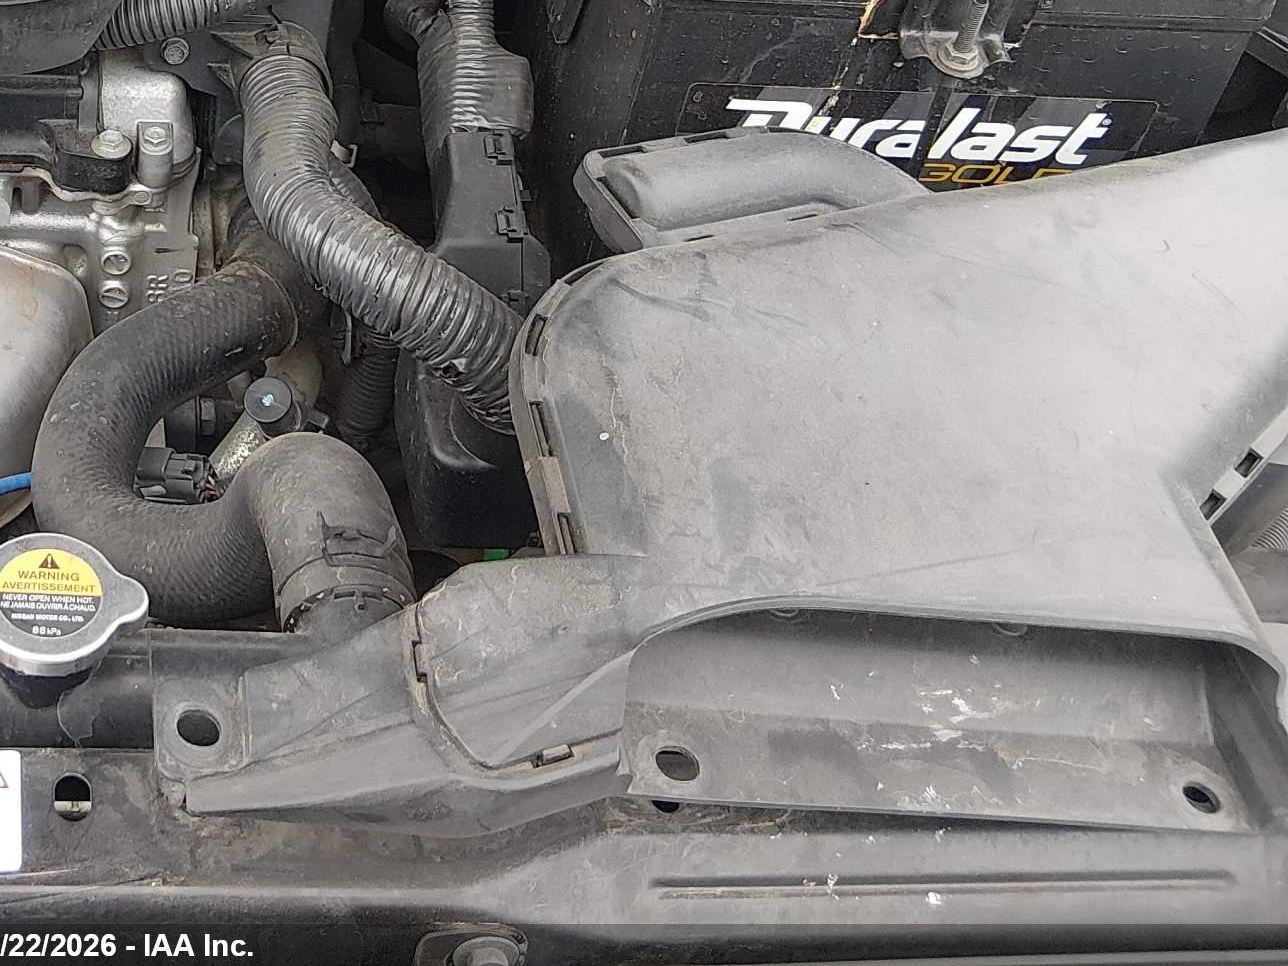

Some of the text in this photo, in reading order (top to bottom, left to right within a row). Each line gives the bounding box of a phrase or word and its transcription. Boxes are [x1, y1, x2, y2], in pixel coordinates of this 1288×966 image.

[725, 97, 1109, 166] Duralast
[18, 569, 80, 581] WARNING
[2, 581, 96, 593] AVERTISSEMENT
[2, 593, 95, 604] NEVER OPEN WHEN HOT.
[10, 601, 35, 610] JAMAIS
[47, 626, 62, 636] kPa
